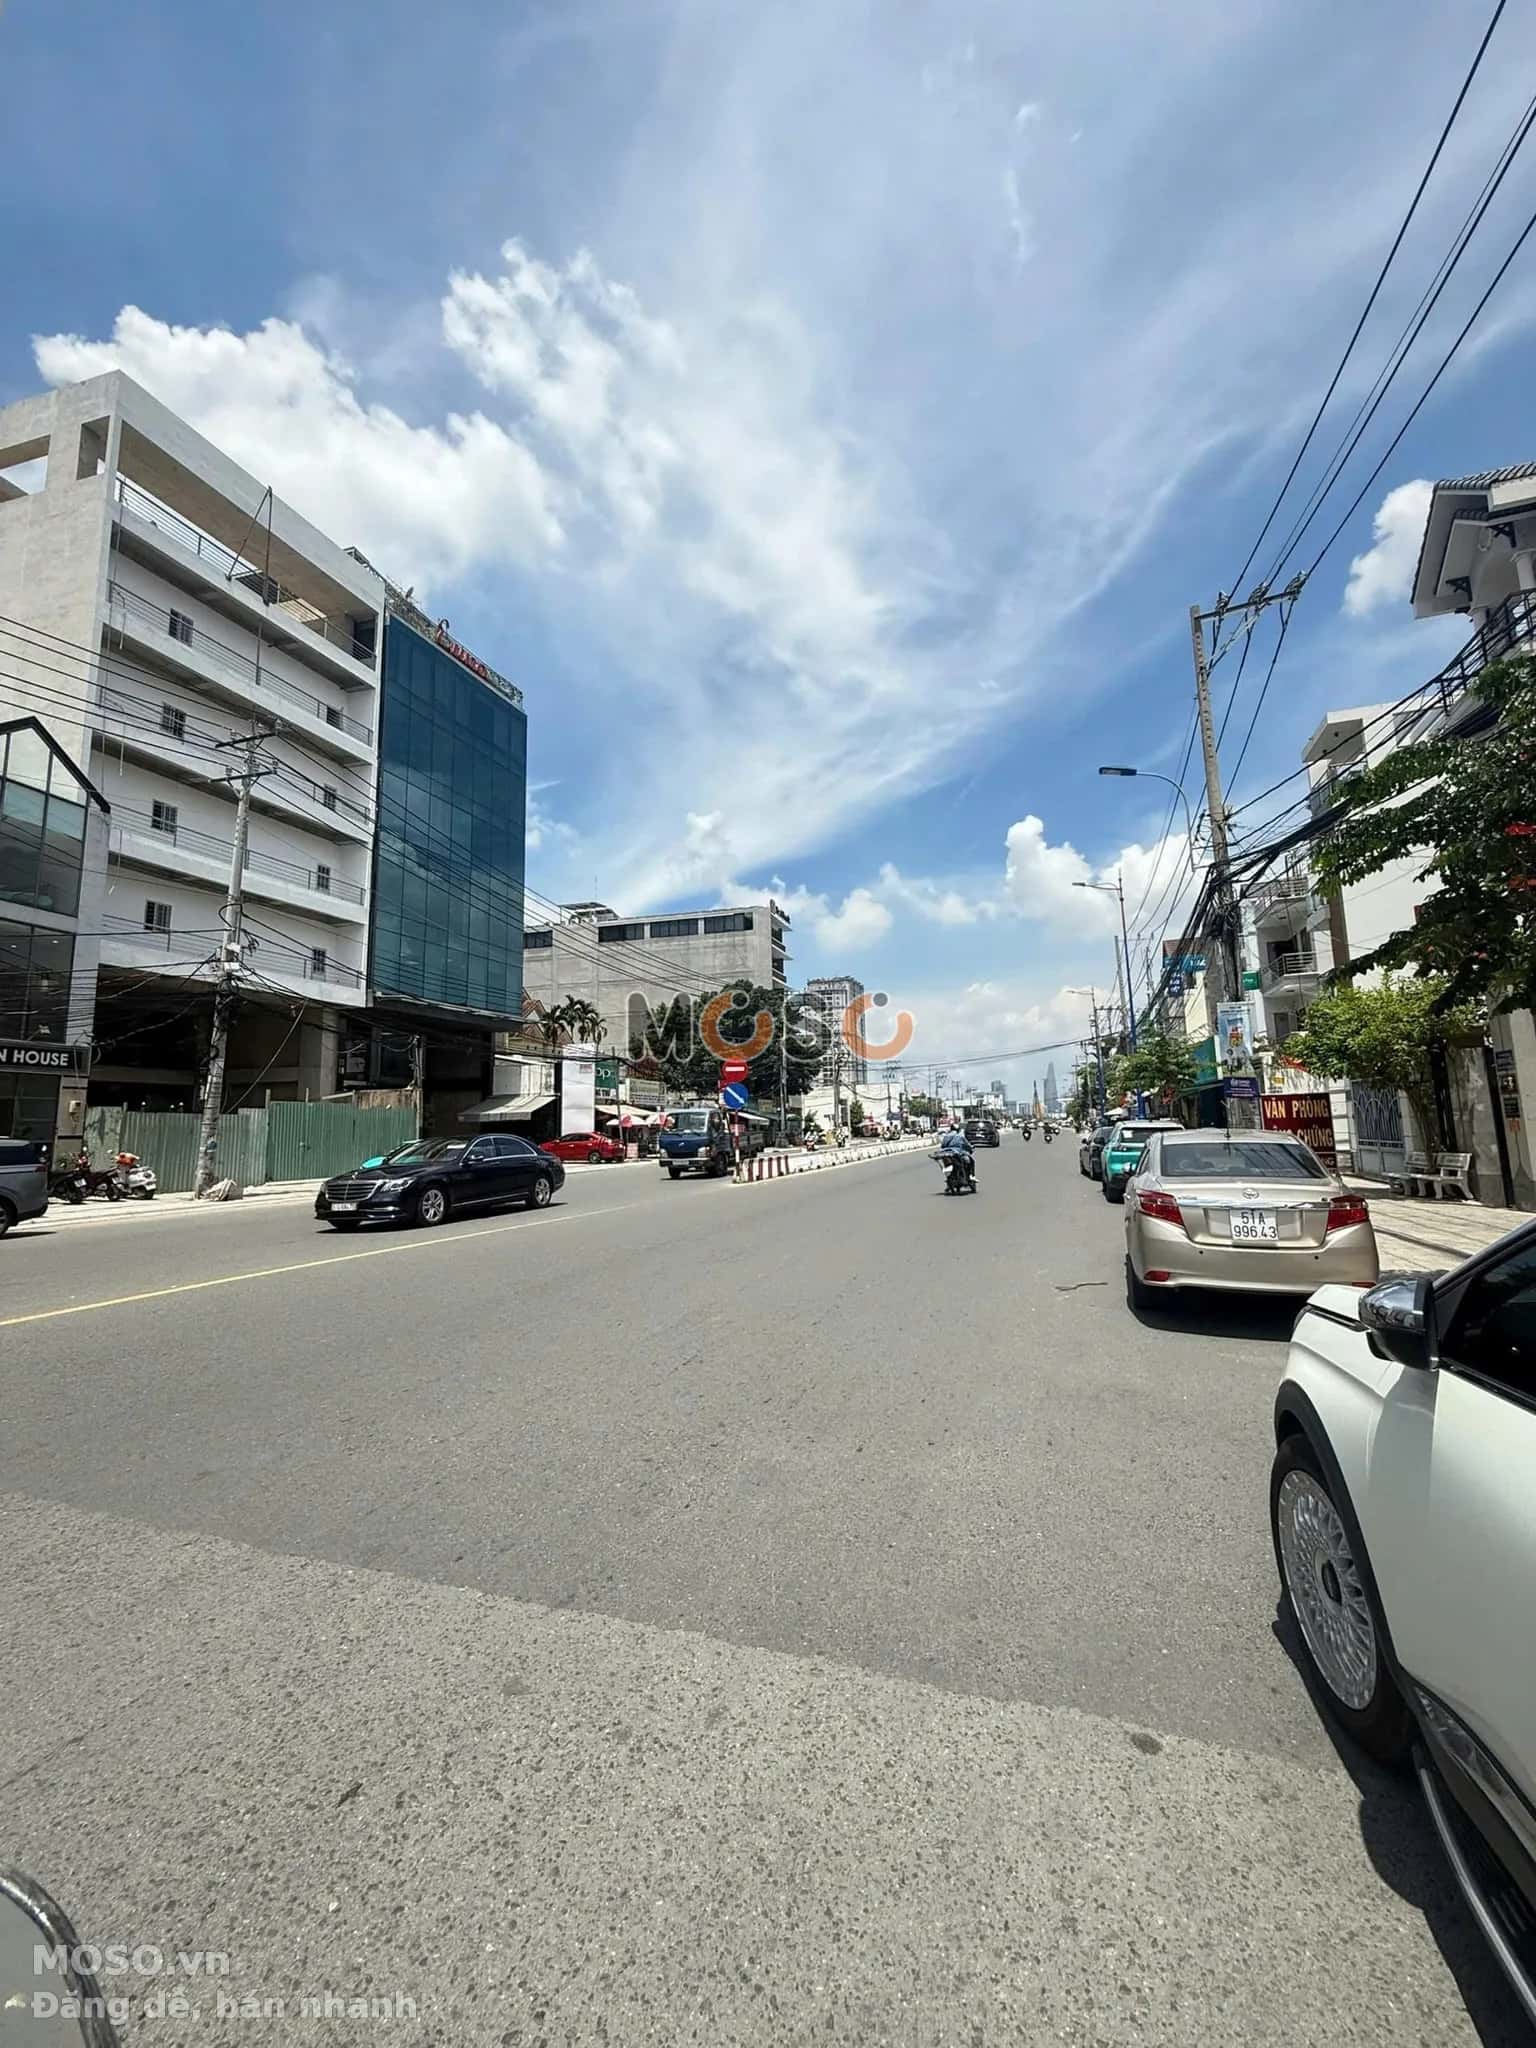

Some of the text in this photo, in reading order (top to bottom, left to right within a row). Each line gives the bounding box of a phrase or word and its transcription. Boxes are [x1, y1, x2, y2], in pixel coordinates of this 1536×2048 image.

[13, 1049, 69, 1066] HOUSE
[1292, 1096, 1329, 1118] PHÒNG
[1241, 1211, 1266, 1225] 51A
